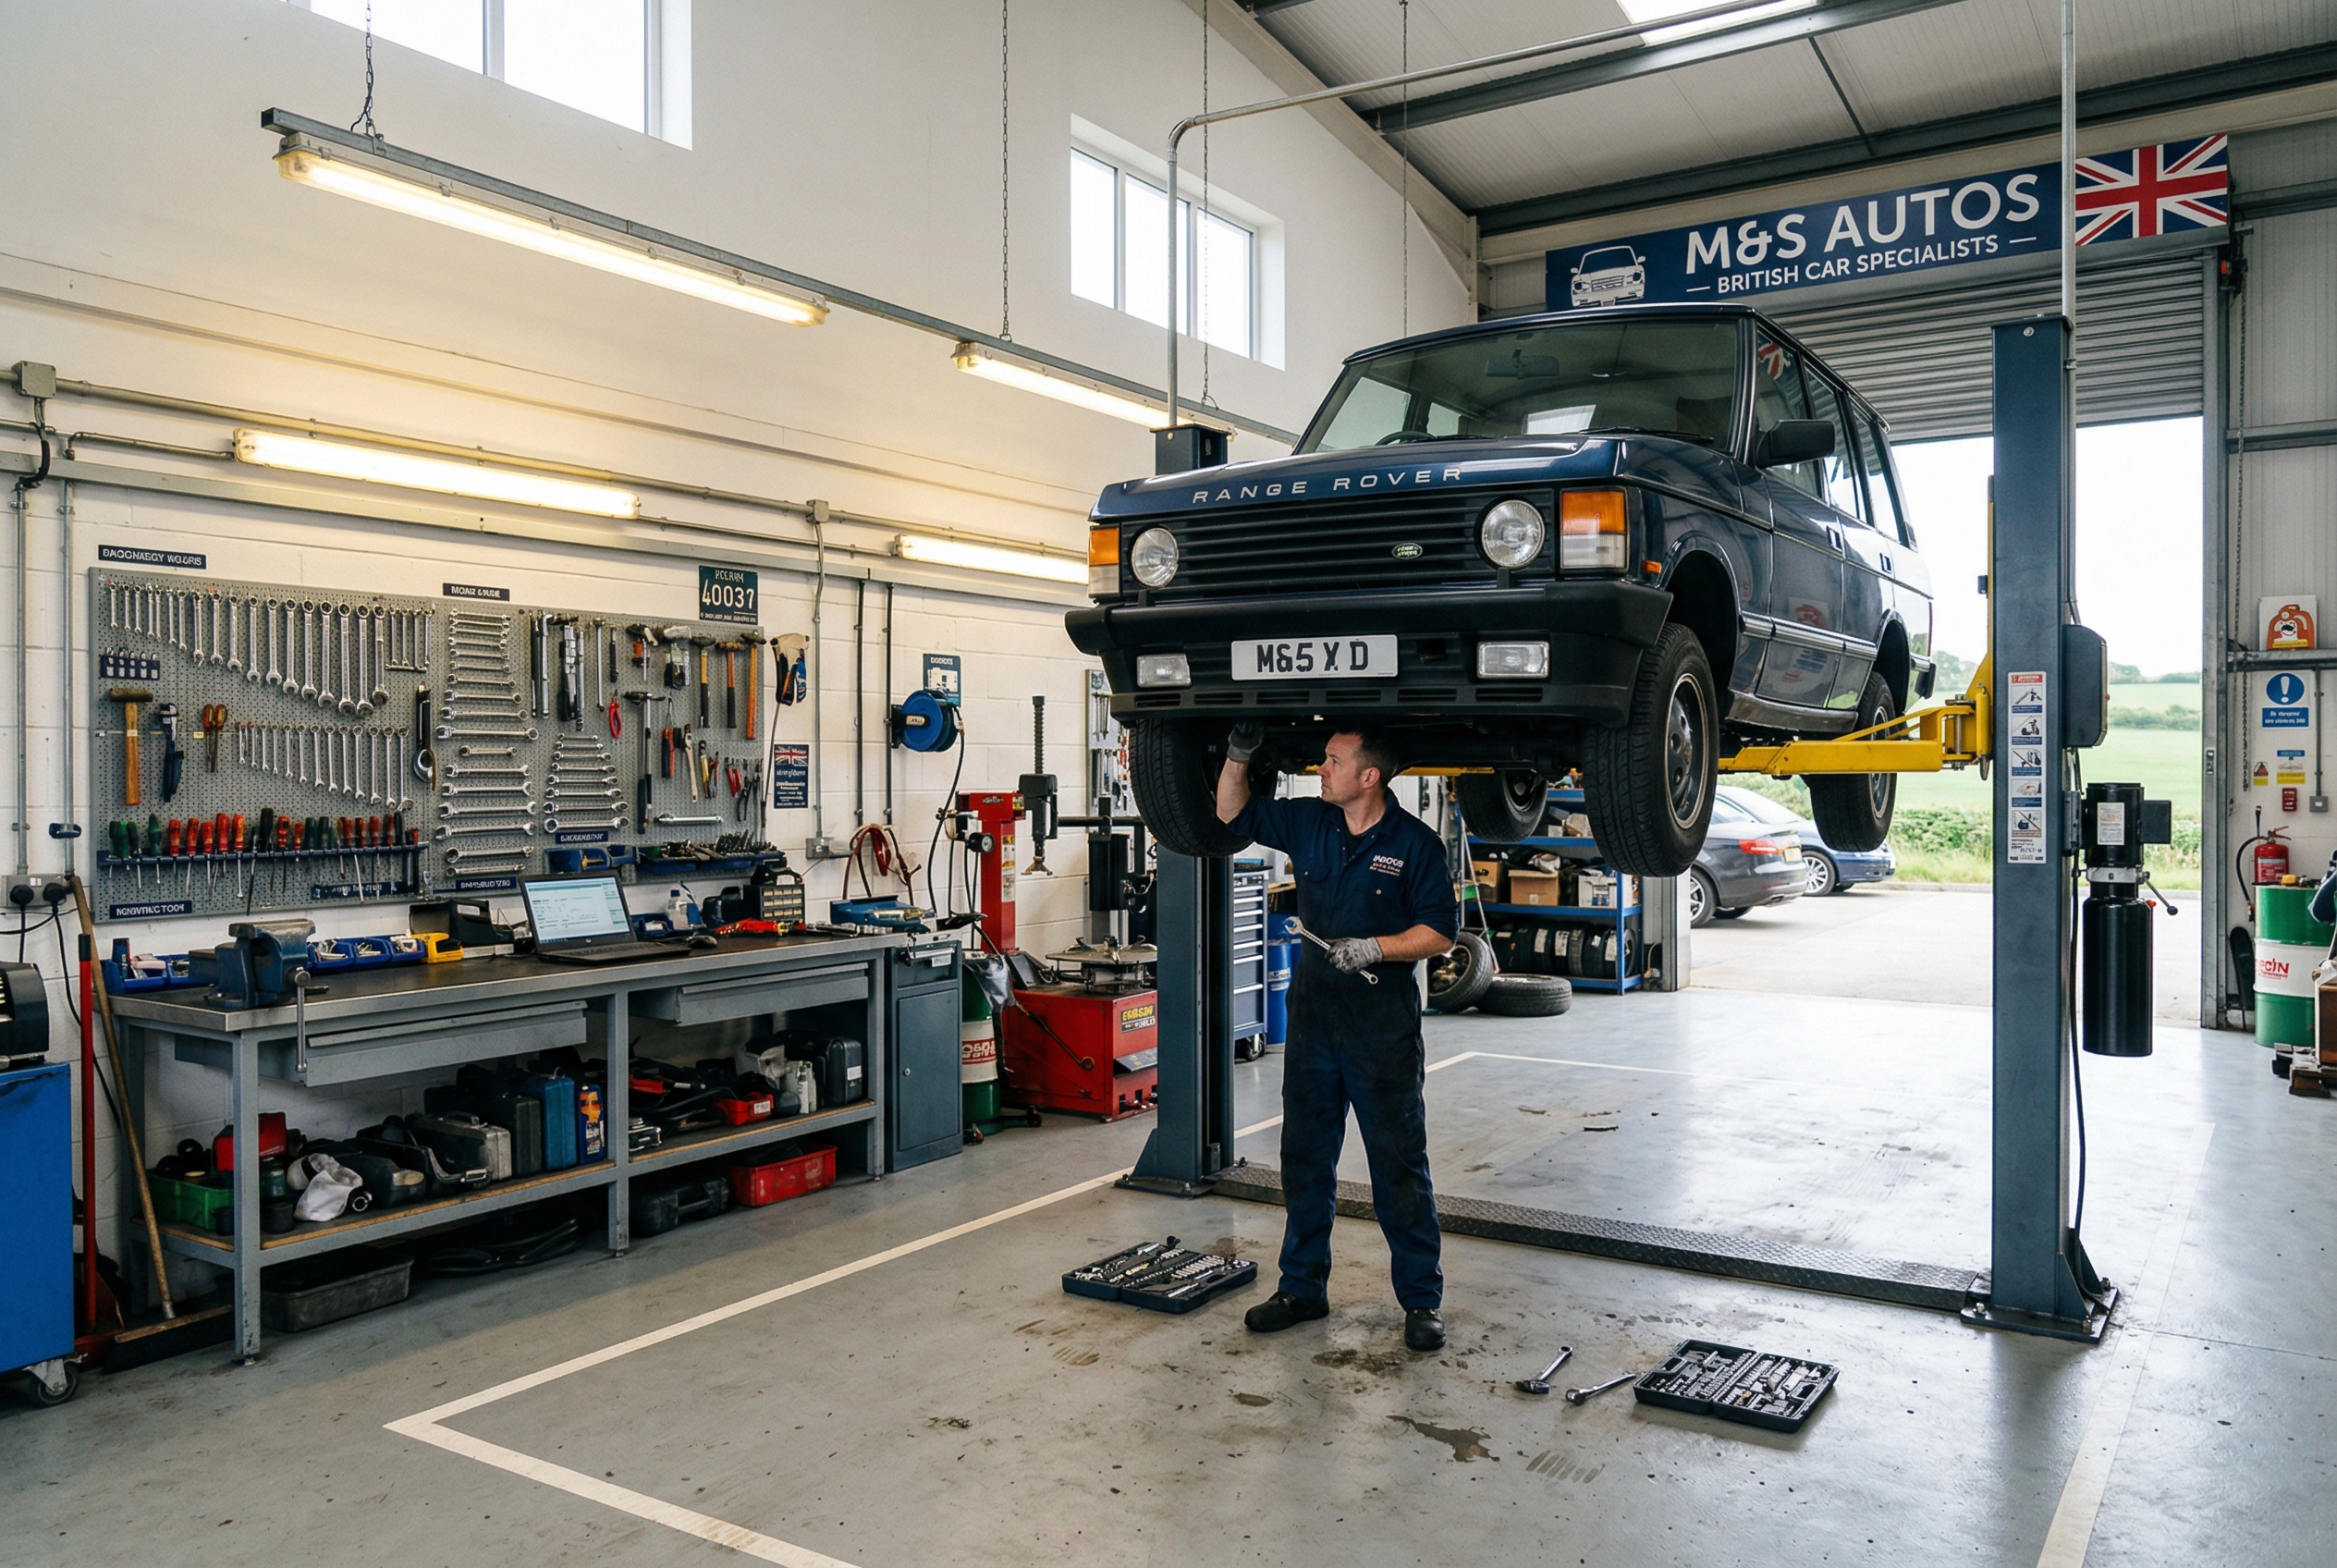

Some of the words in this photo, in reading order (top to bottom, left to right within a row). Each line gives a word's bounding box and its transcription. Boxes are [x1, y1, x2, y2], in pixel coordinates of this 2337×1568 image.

[1686, 214, 1806, 275] M&S
[1823, 173, 2039, 253] AUTOS
[1718, 264, 1799, 294] BRITISH
[1805, 257, 1851, 280] CAR
[1856, 234, 1999, 273] SPECIALISTS
[1193, 481, 1307, 504] RANGE
[1333, 468, 1462, 491] ROVER
[702, 579, 754, 609] 40037
